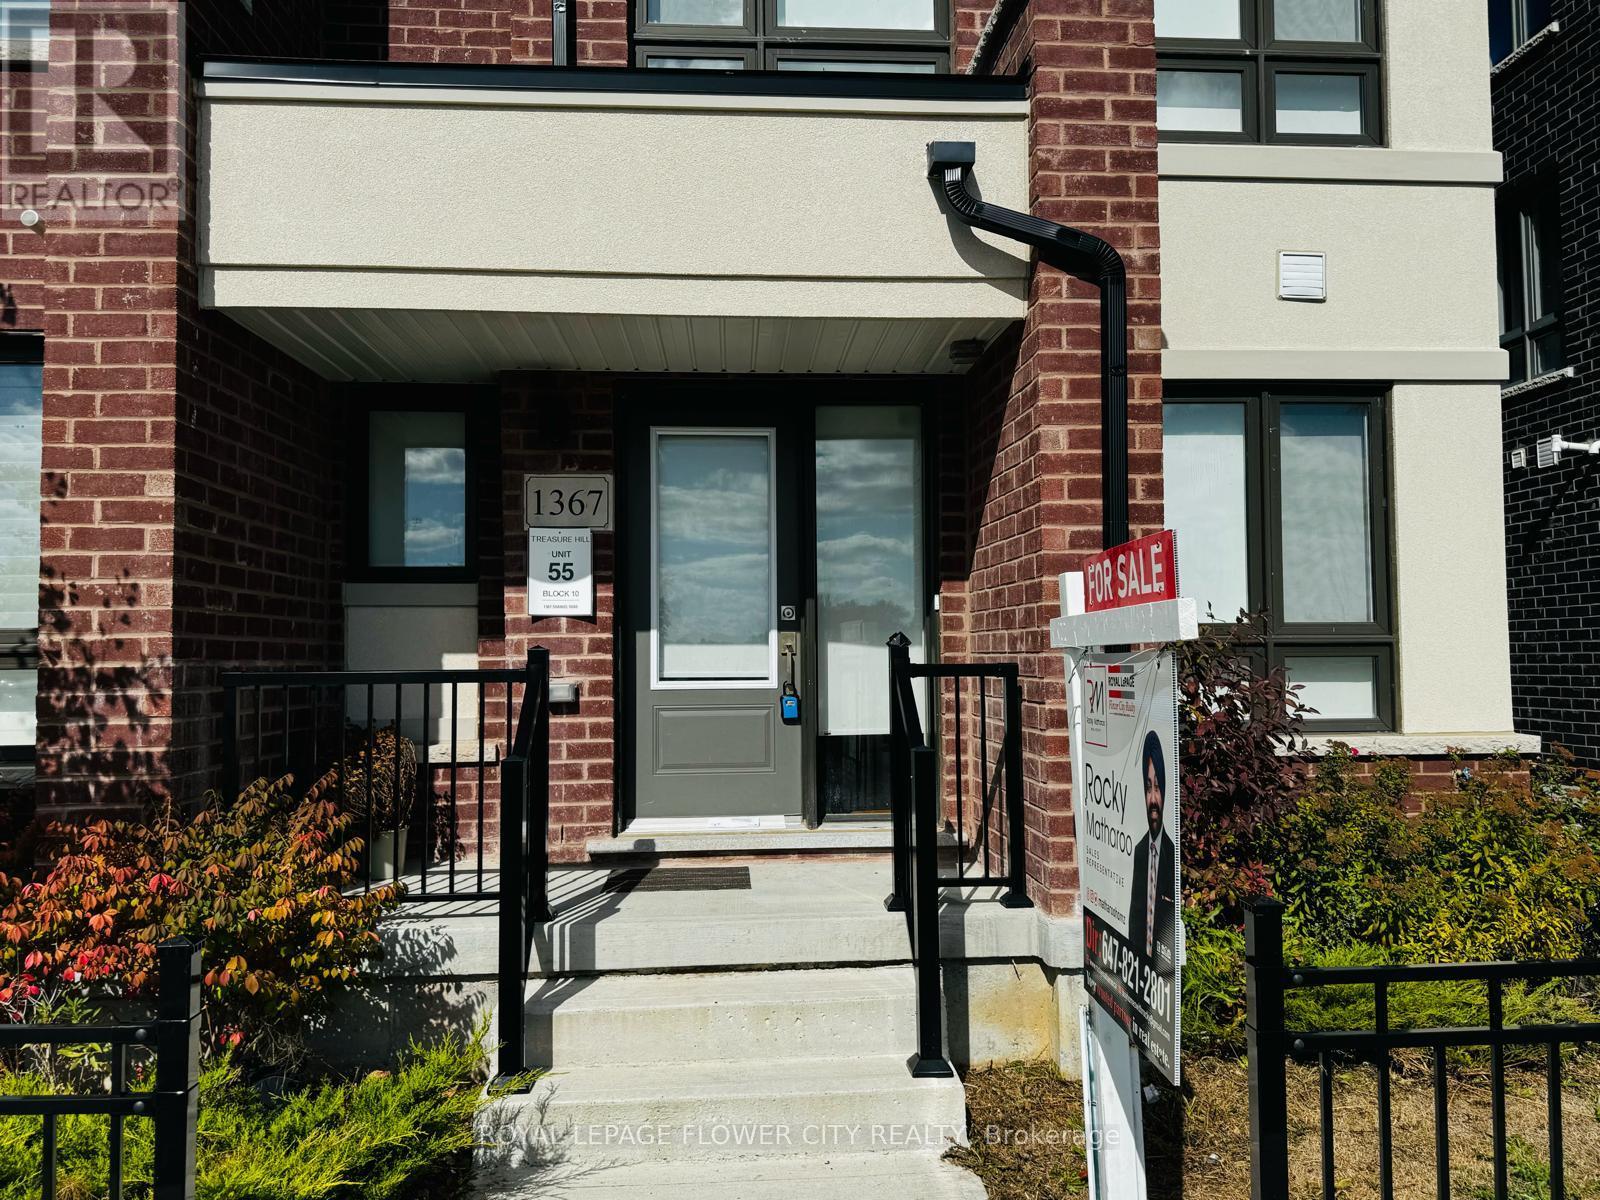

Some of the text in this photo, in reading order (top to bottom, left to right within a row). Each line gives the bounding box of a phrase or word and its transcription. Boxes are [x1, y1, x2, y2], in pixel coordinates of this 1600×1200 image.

[533, 489, 603, 516] 1367
[531, 535, 573, 543] TREASURE
[551, 550, 572, 558] UNIT
[548, 562, 574, 581] 55
[1088, 541, 1165, 605] FOR SALE
[1084, 762, 1128, 825] Rocky
[1086, 809, 1133, 857] Matharoo
[1086, 846, 1100, 860] SALES
[1086, 857, 1125, 888] REPRESENTATIVE
[1102, 929, 1171, 1023] 647-821-2801
[1132, 1016, 1138, 1036] in
[1139, 1027, 1150, 1049] real
